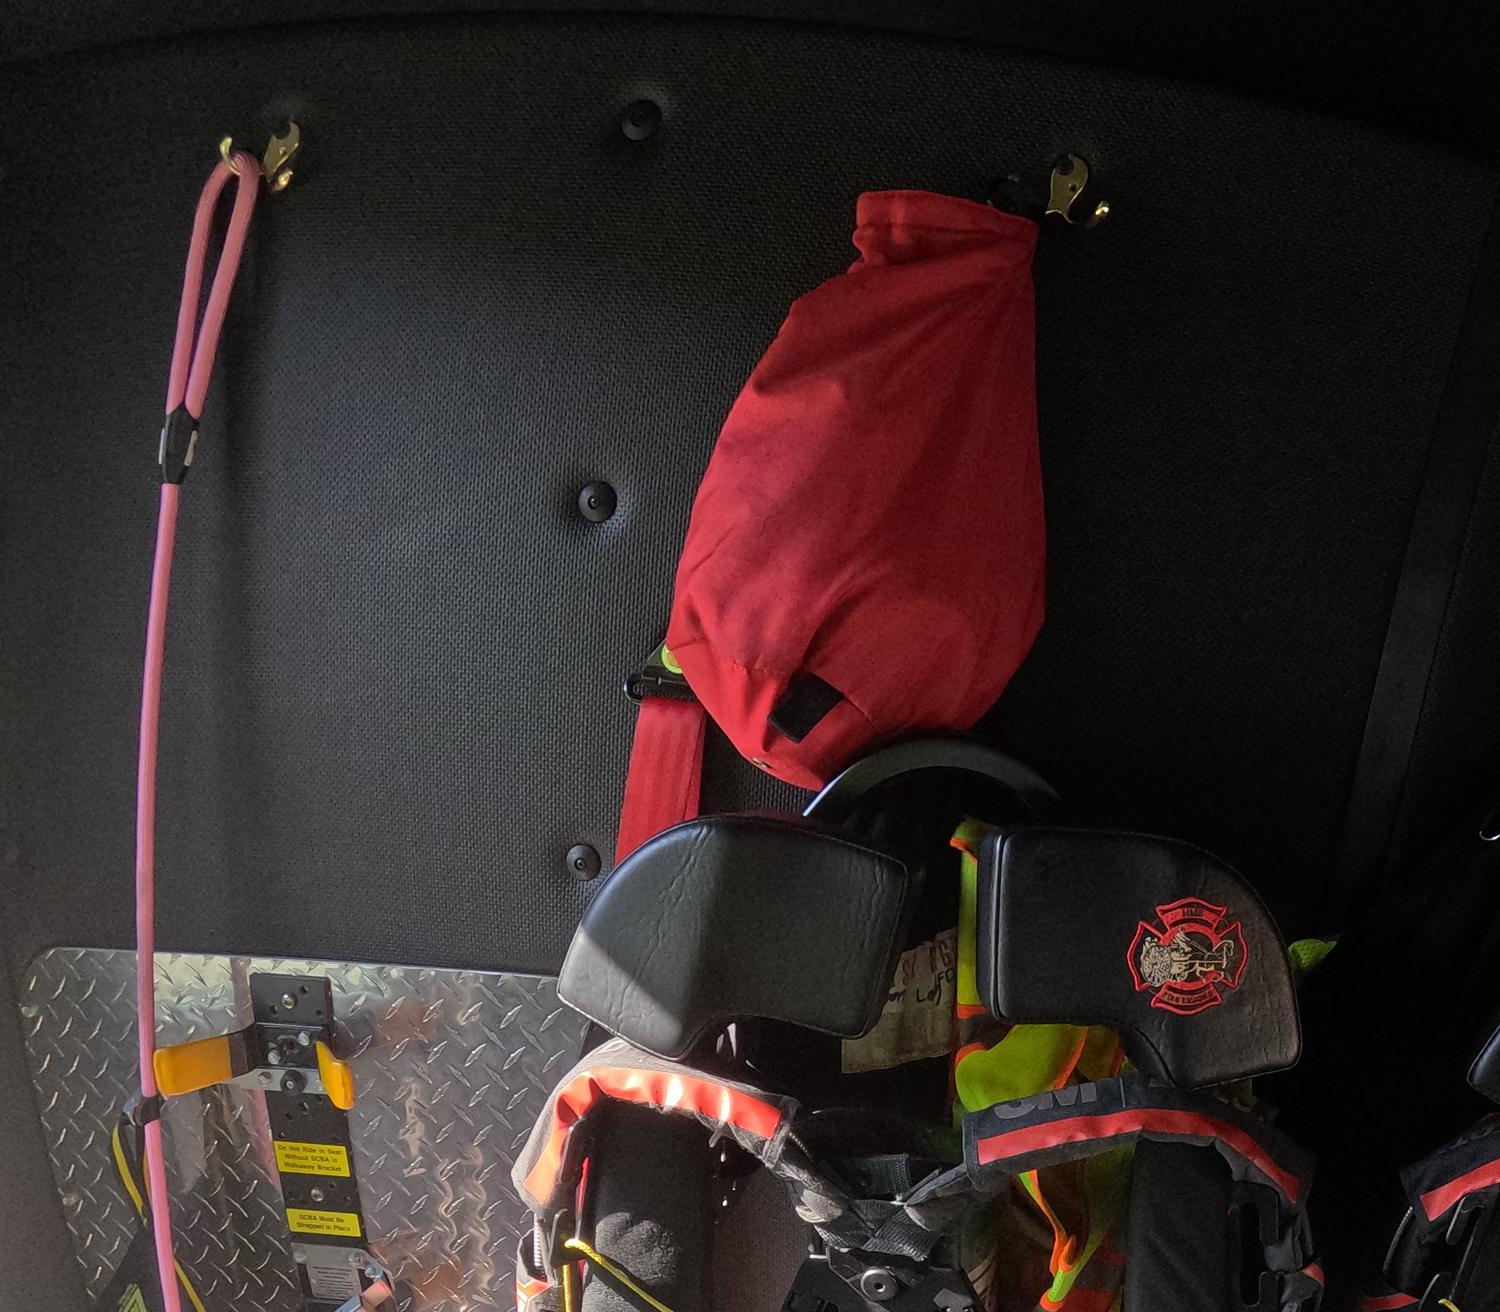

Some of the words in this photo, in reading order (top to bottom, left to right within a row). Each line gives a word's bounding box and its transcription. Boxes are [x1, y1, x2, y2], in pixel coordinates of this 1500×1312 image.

[284, 1153, 309, 1161] Without
[284, 1162, 315, 1171] Walkaway
[317, 1164, 342, 1172] Bracket
[296, 1222, 325, 1230] Strapped
[333, 1224, 351, 1232] Place
